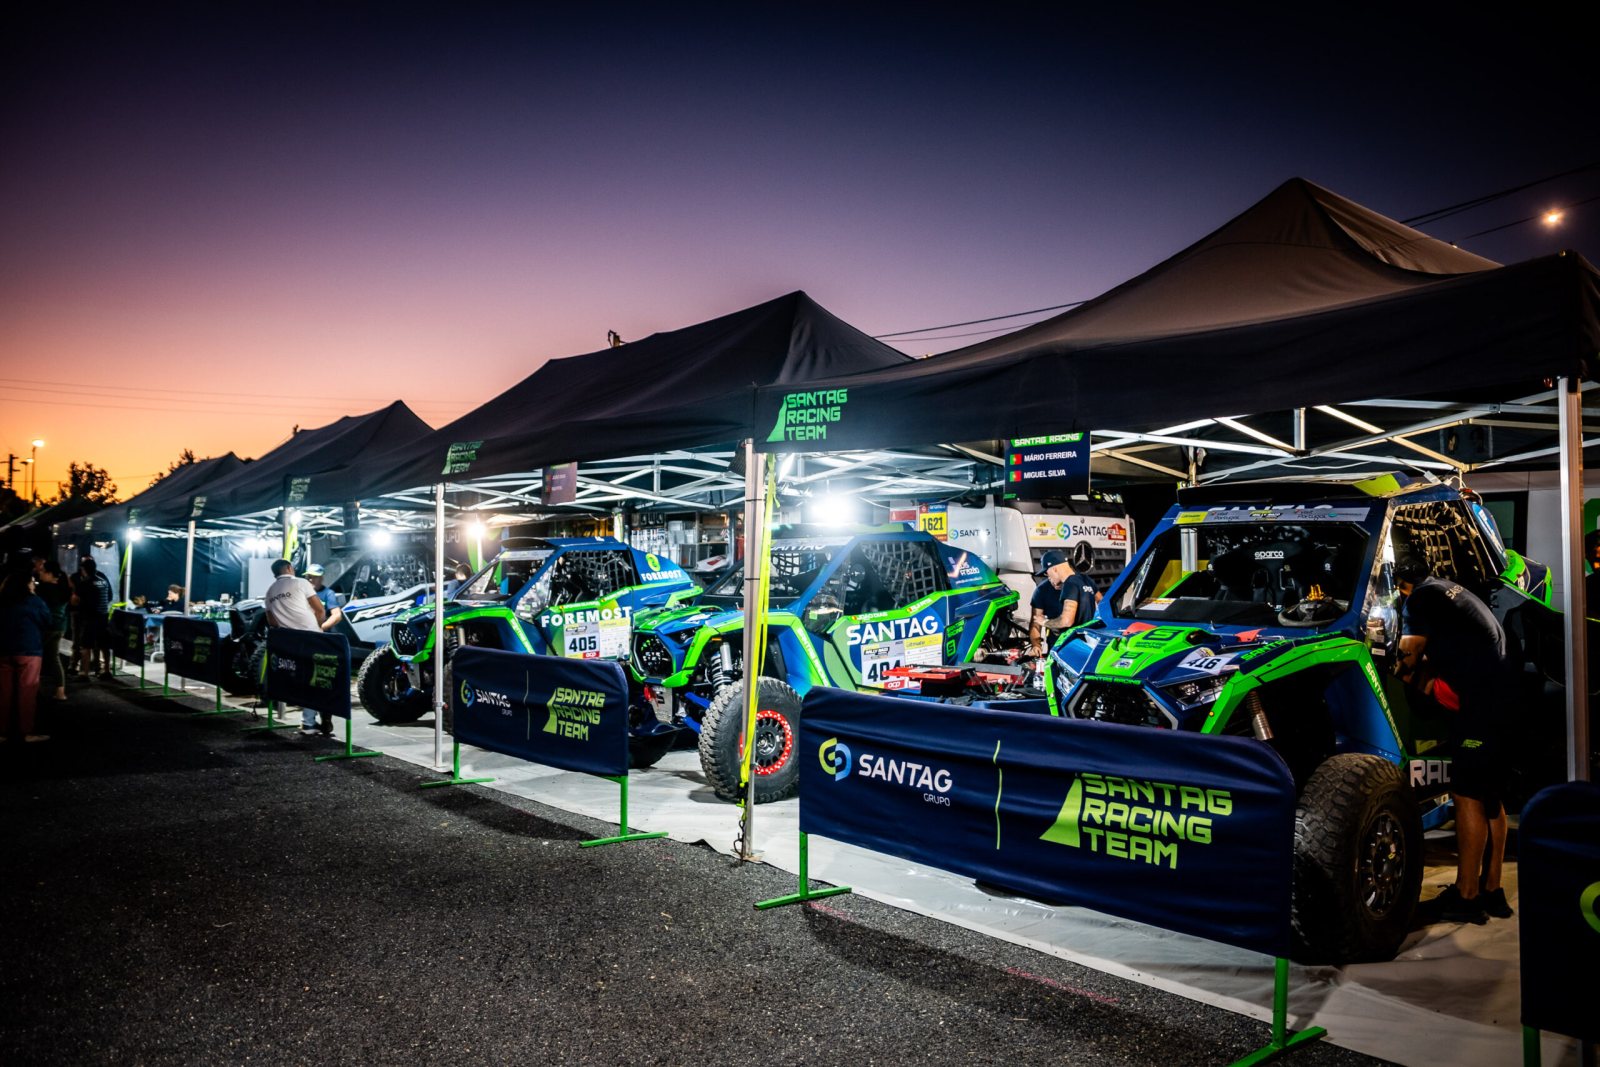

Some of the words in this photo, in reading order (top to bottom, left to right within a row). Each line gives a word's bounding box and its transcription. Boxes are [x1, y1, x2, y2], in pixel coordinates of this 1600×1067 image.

[786, 389, 848, 409] SANTAG
[786, 406, 841, 425] RACING
[785, 425, 827, 441] TEAM
[1014, 438, 1047, 447] SANTAG
[1049, 432, 1080, 443] RACING
[1024, 452, 1045, 462] MÁRIO
[1045, 450, 1077, 461] FERREIRA
[1023, 471, 1047, 479] MIGUEL
[1047, 469, 1066, 478] SILVA
[922, 517, 944, 531] 1621
[959, 529, 991, 538] SANTG
[1072, 525, 1108, 537] SANTAG
[640, 569, 683, 582] FOREMOST
[541, 606, 633, 628] FOREMOST
[846, 616, 939, 646] SANTAG
[569, 636, 597, 652] 405
[475, 689, 511, 708] SANTAG
[555, 687, 606, 708] SANTAG
[553, 704, 601, 725] RACING
[557, 719, 589, 742] TEAM
[858, 753, 953, 793] SANTAG
[923, 793, 951, 807] GRUPO
[1081, 772, 1233, 817] SANTAG
[1081, 797, 1213, 845] RACING
[1082, 826, 1178, 870] TEAM
